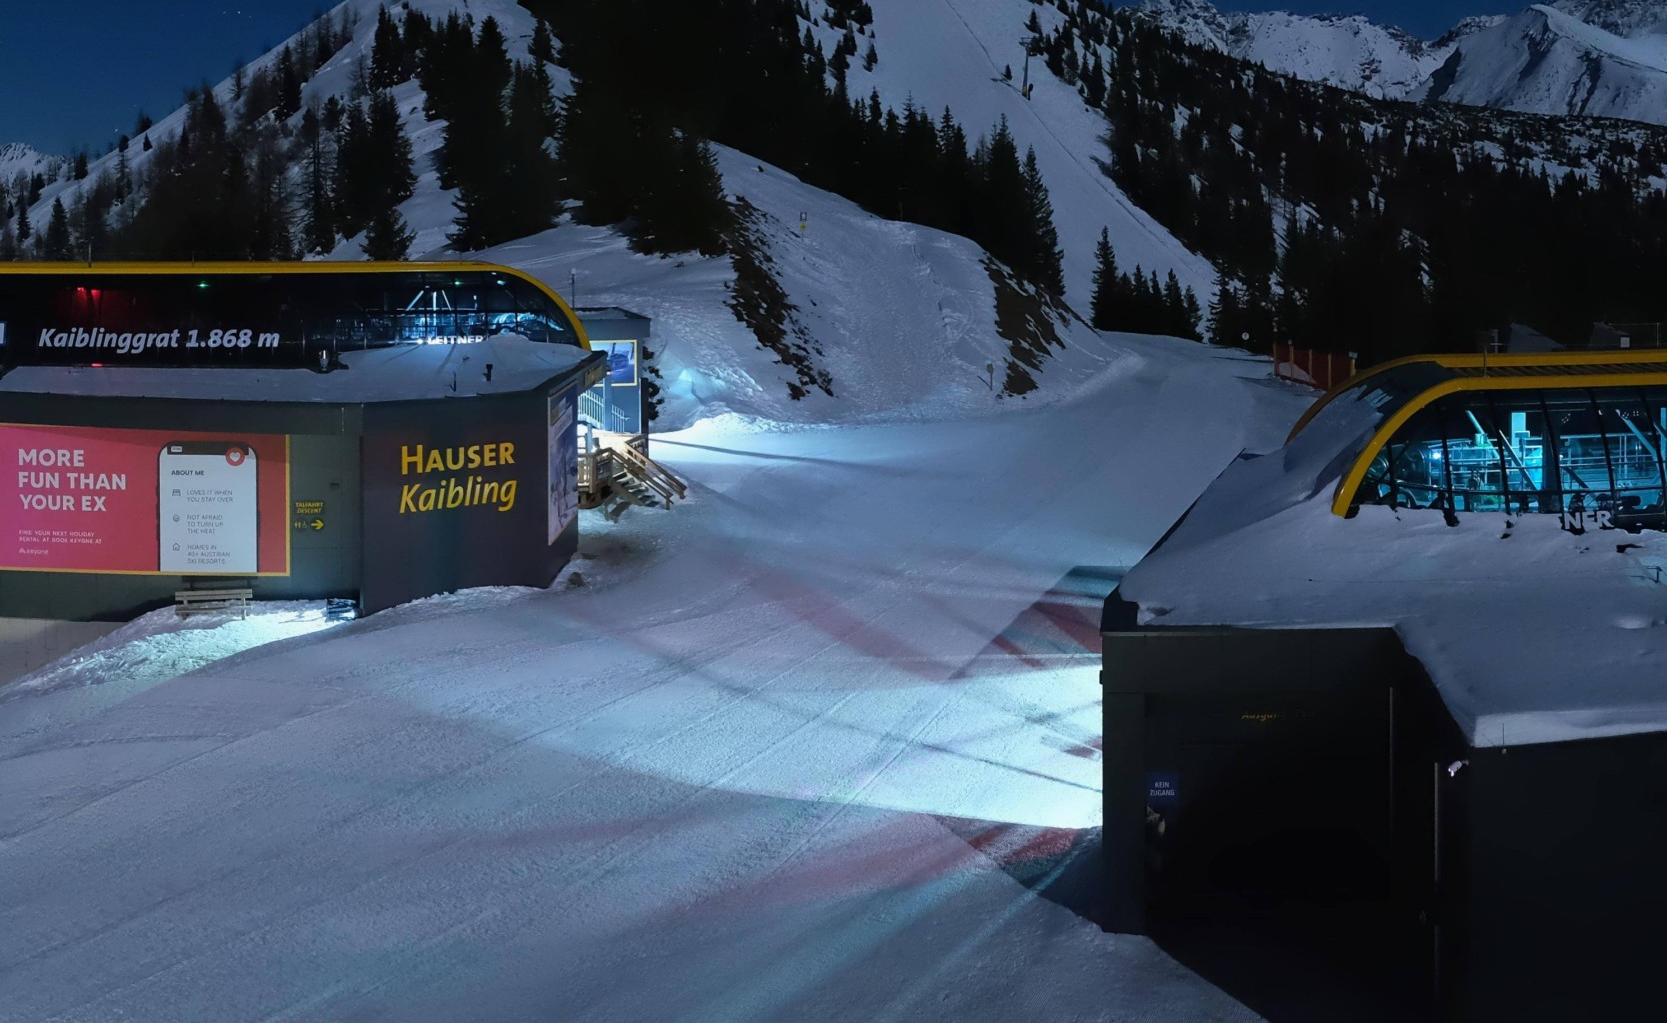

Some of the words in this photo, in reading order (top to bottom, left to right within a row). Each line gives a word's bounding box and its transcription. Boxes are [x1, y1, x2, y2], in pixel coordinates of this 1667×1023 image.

[38, 328, 178, 354] Kaiblinggrat
[185, 329, 253, 348] 1.868
[258, 332, 280, 348] m
[427, 335, 484, 345] LEITNER
[18, 449, 85, 467] MORE
[401, 442, 516, 475] HAUSER
[18, 472, 59, 489] FUN
[67, 472, 126, 490] THAN
[20, 494, 75, 511] YOUR
[81, 496, 106, 511] EX
[399, 476, 517, 513] Kaibling
